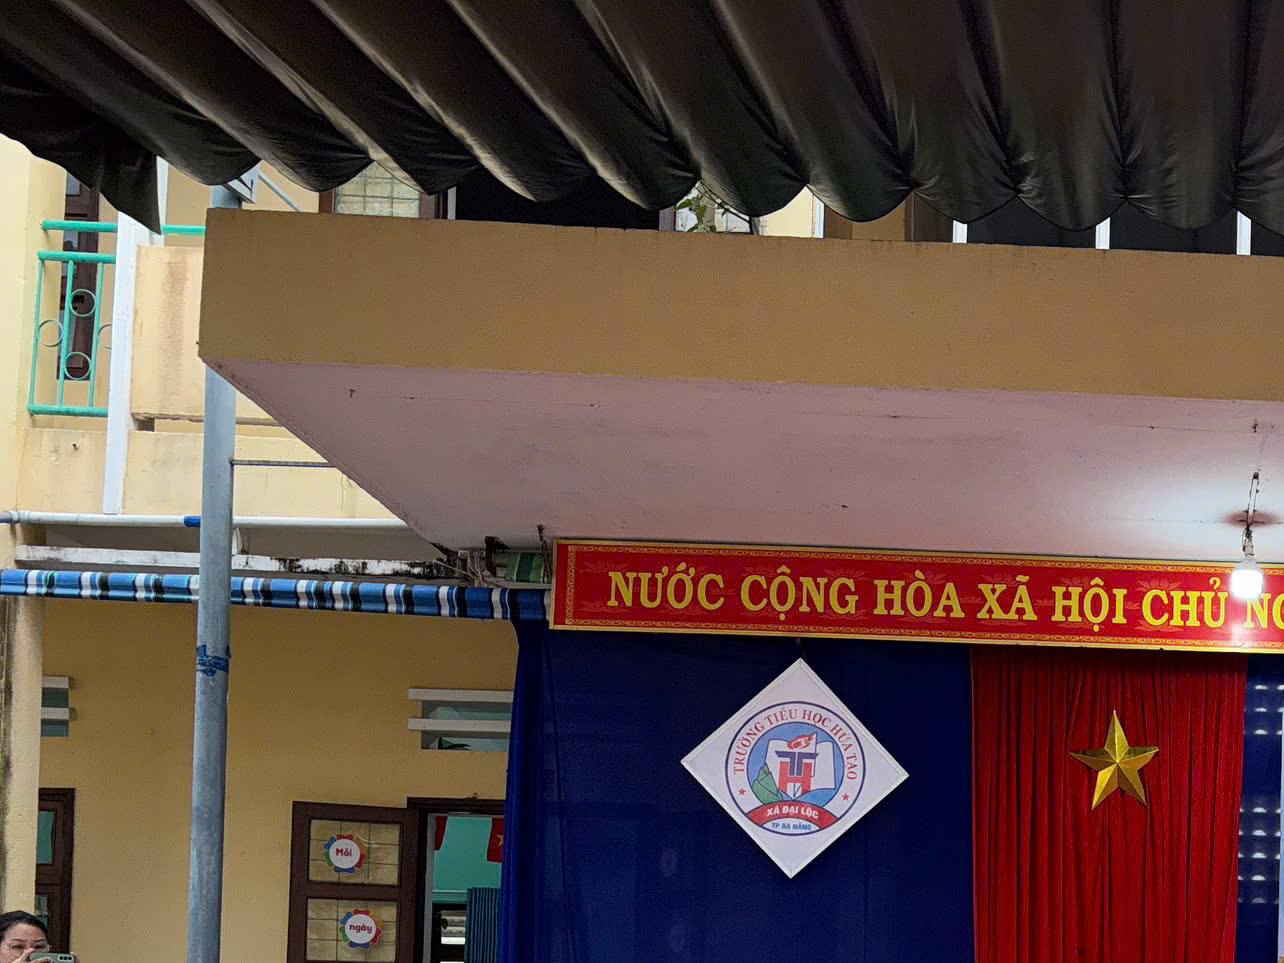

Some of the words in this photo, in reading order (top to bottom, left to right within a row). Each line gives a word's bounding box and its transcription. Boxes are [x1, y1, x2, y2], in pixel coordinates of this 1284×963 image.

[607, 562, 725, 608] NƯỚC
[740, 566, 858, 622] CỘNG
[872, 572, 964, 619] HÒA
[977, 575, 1037, 621] XÃ
[1051, 577, 1127, 633] HỘI
[1142, 577, 1227, 627] CHỦ
[733, 721, 765, 775] TRƯỜNG
[764, 708, 798, 725] TIỂU
[802, 710, 832, 728] HỌC
[830, 724, 853, 751] HỨA
[782, 806, 798, 816] ĐẠI
[349, 923, 372, 934] ngày
